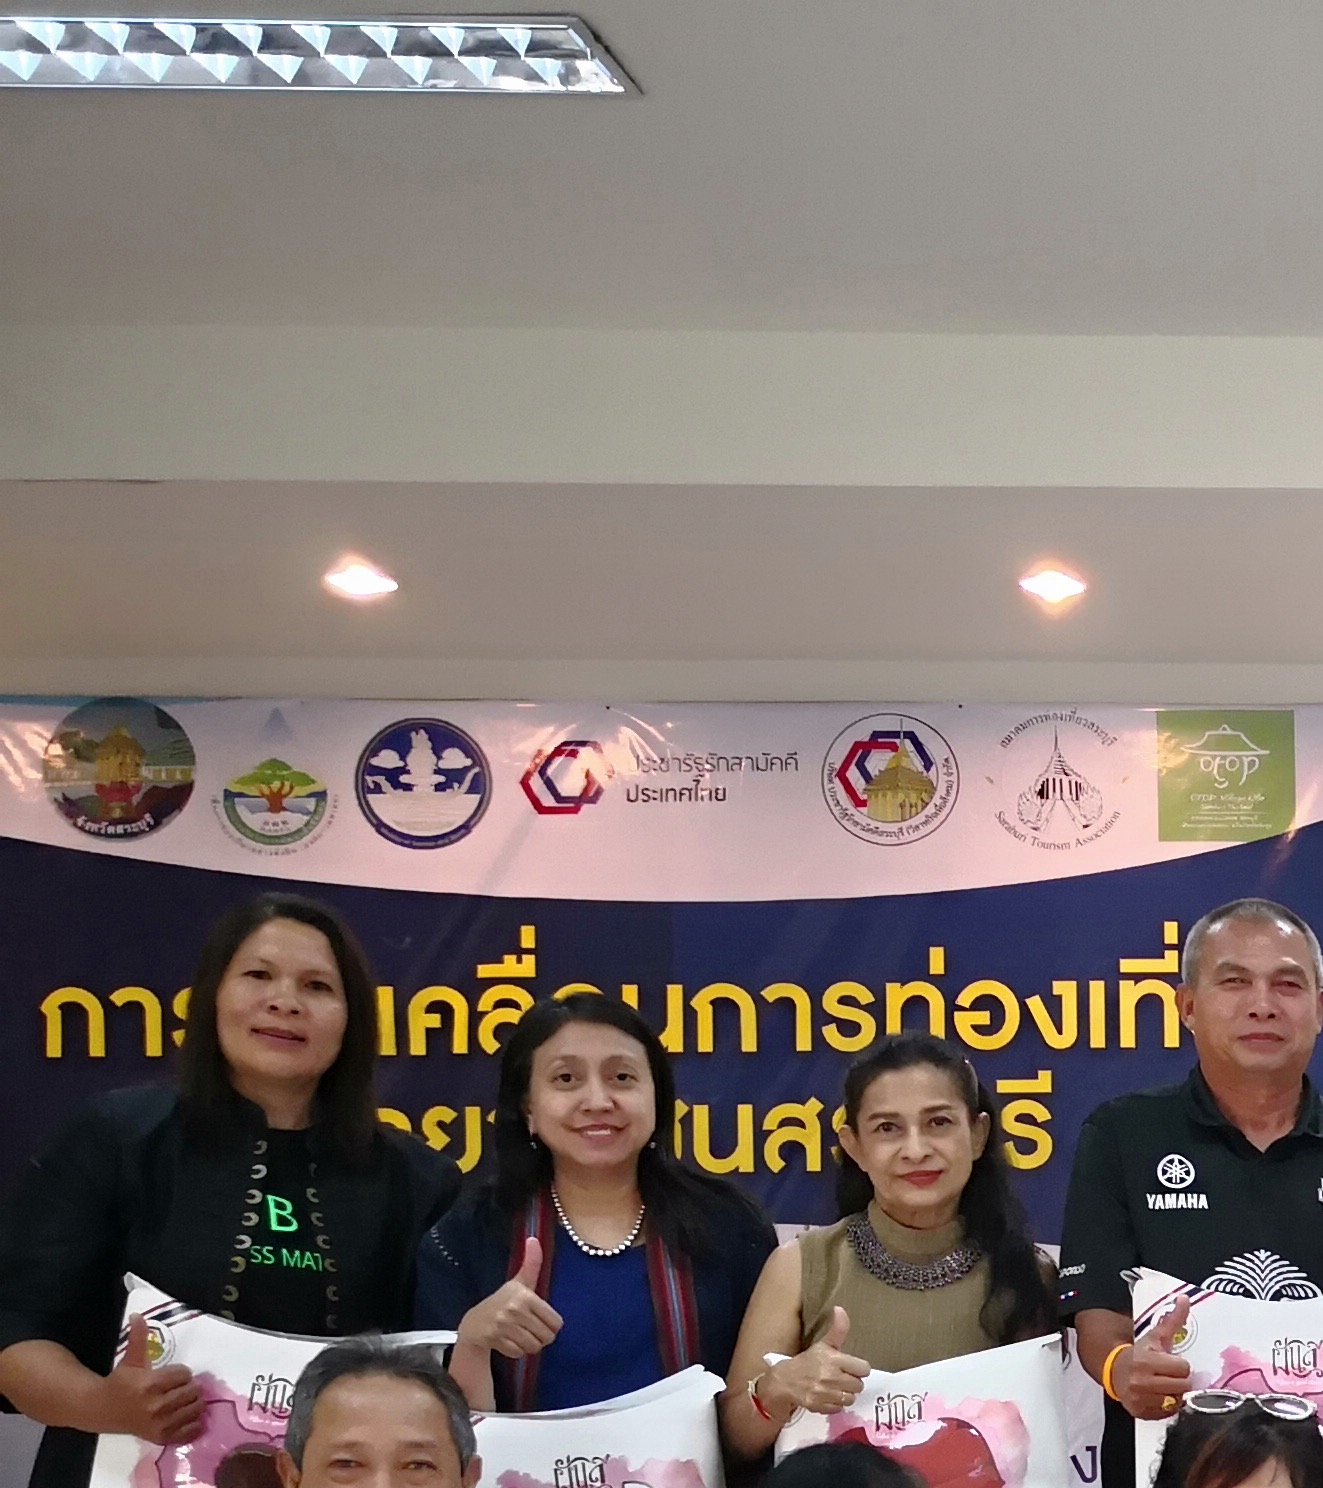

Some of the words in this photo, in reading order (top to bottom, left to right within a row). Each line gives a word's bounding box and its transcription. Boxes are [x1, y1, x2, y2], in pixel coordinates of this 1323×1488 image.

[626, 779, 727, 803] ประเทศไทย
[994, 810, 1028, 844] Saraburi
[1031, 836, 1071, 850] Tourism
[1075, 810, 1121, 848] Association
[1146, 1192, 1209, 1210] YAMAHA
